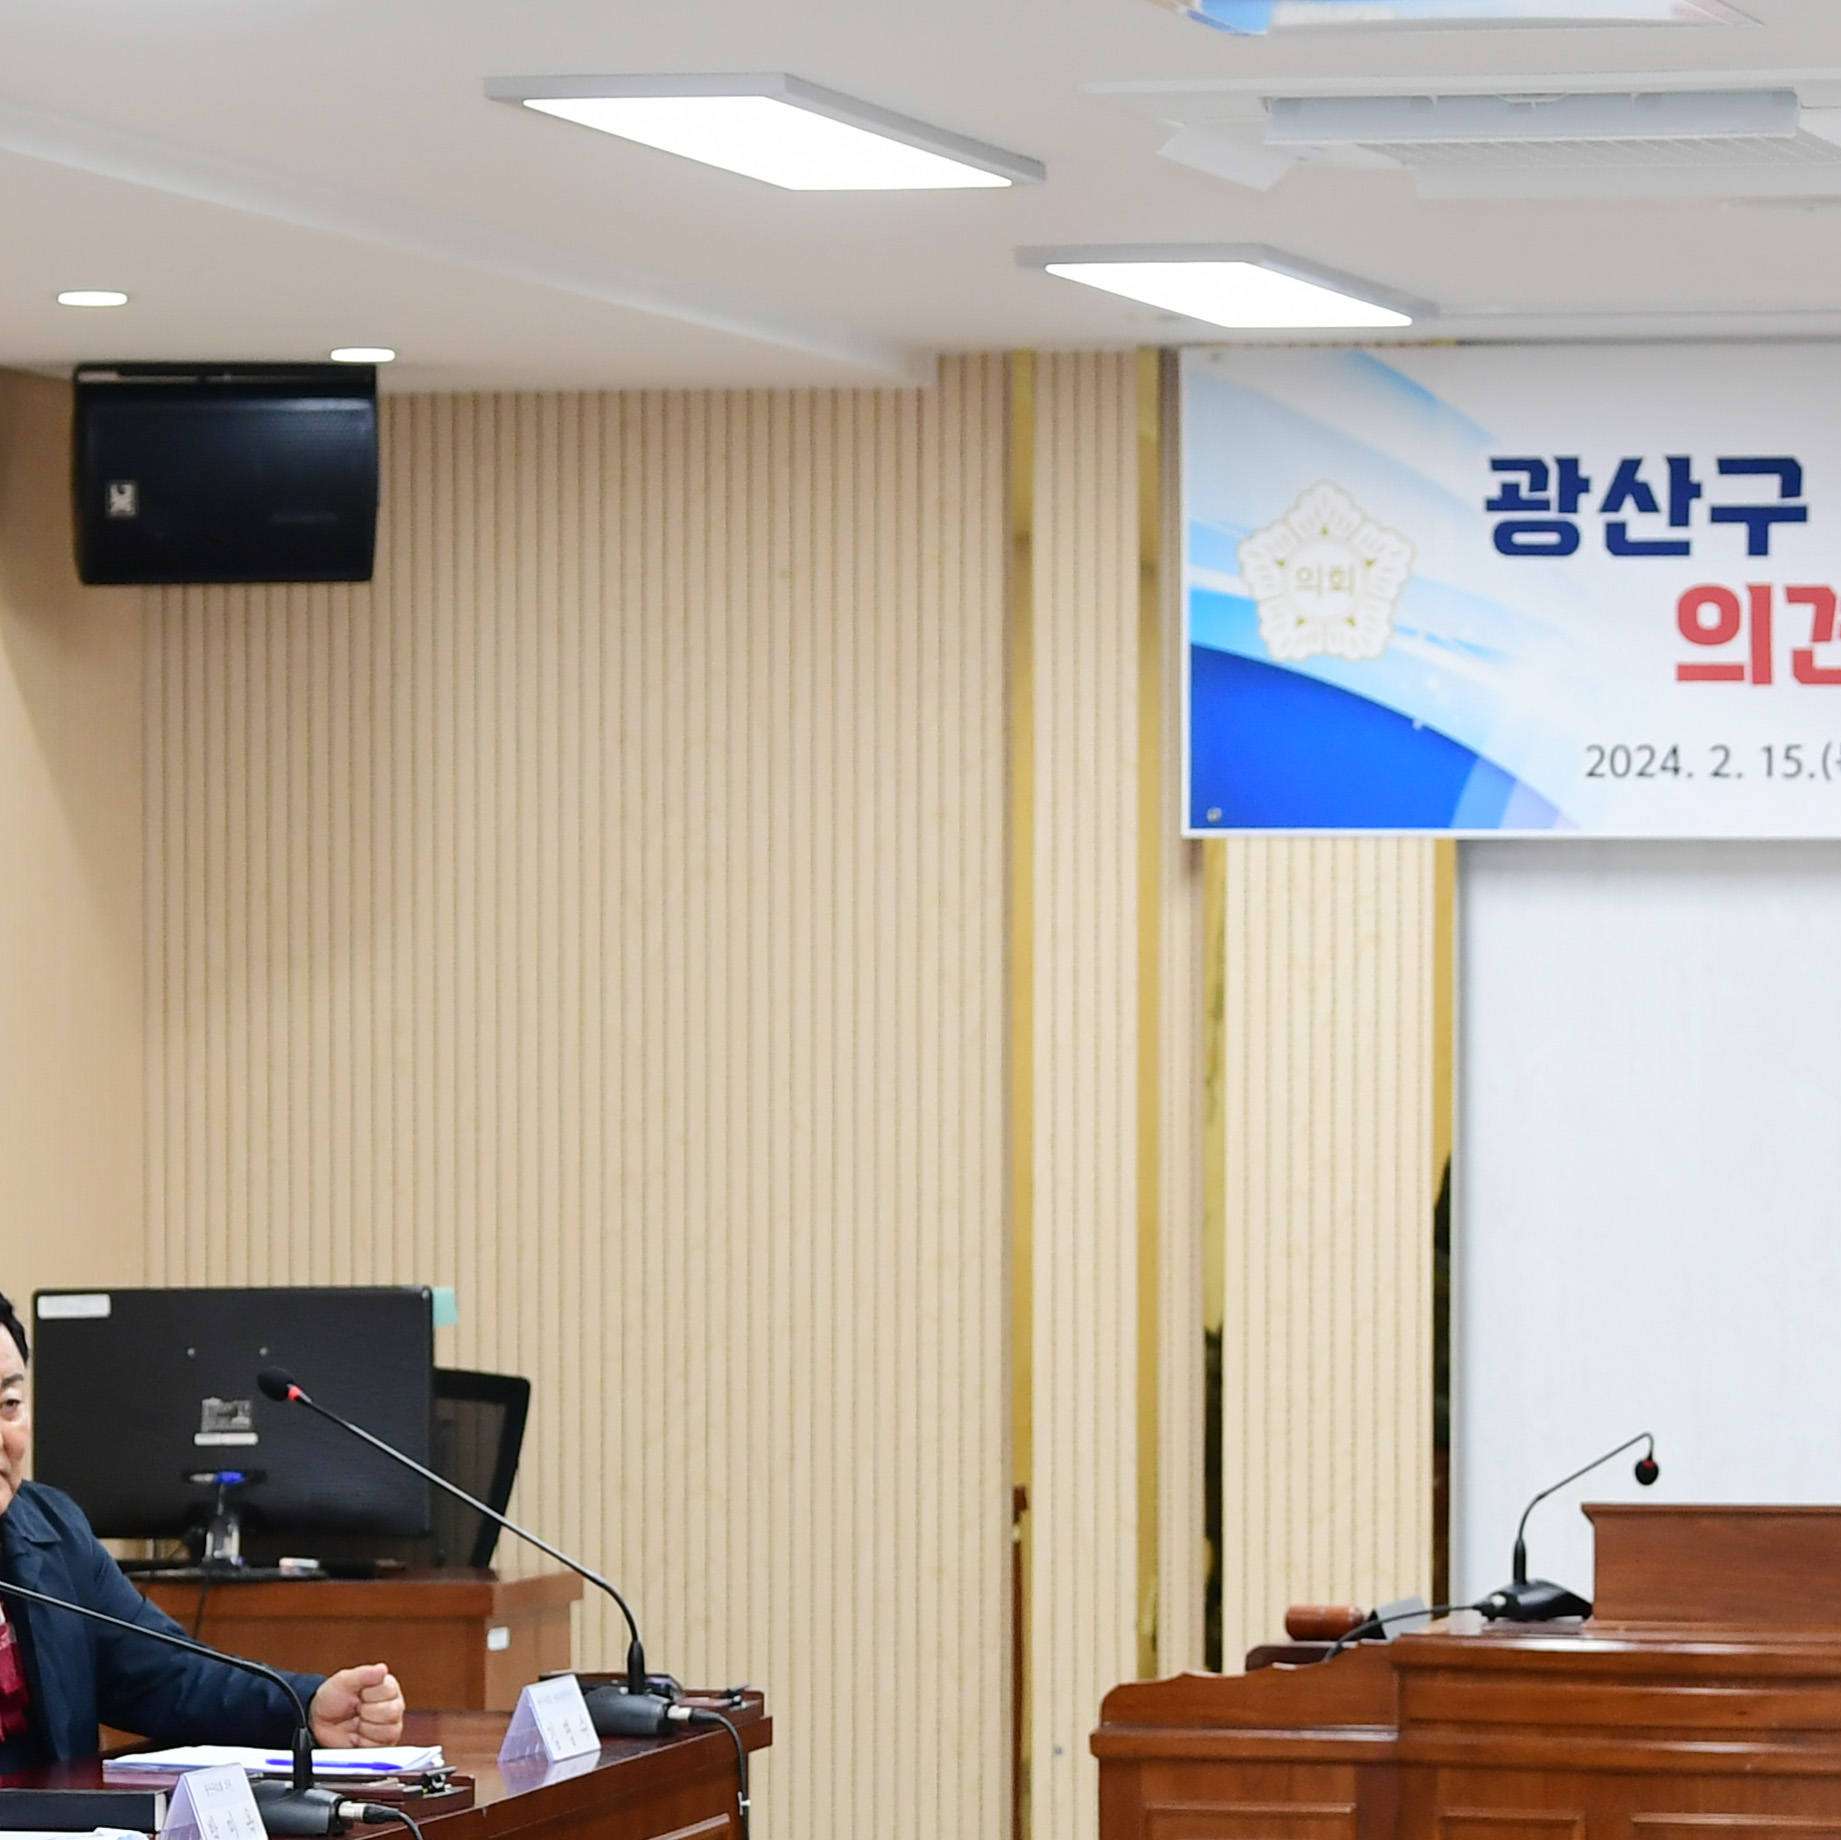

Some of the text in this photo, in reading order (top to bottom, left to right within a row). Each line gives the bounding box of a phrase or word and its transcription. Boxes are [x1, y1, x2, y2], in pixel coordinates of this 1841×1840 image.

[1485, 454, 1808, 556] 광산구
[1296, 564, 1356, 597] 의회
[1585, 742, 1694, 780] 2024.
[1710, 742, 1744, 780] 2.
